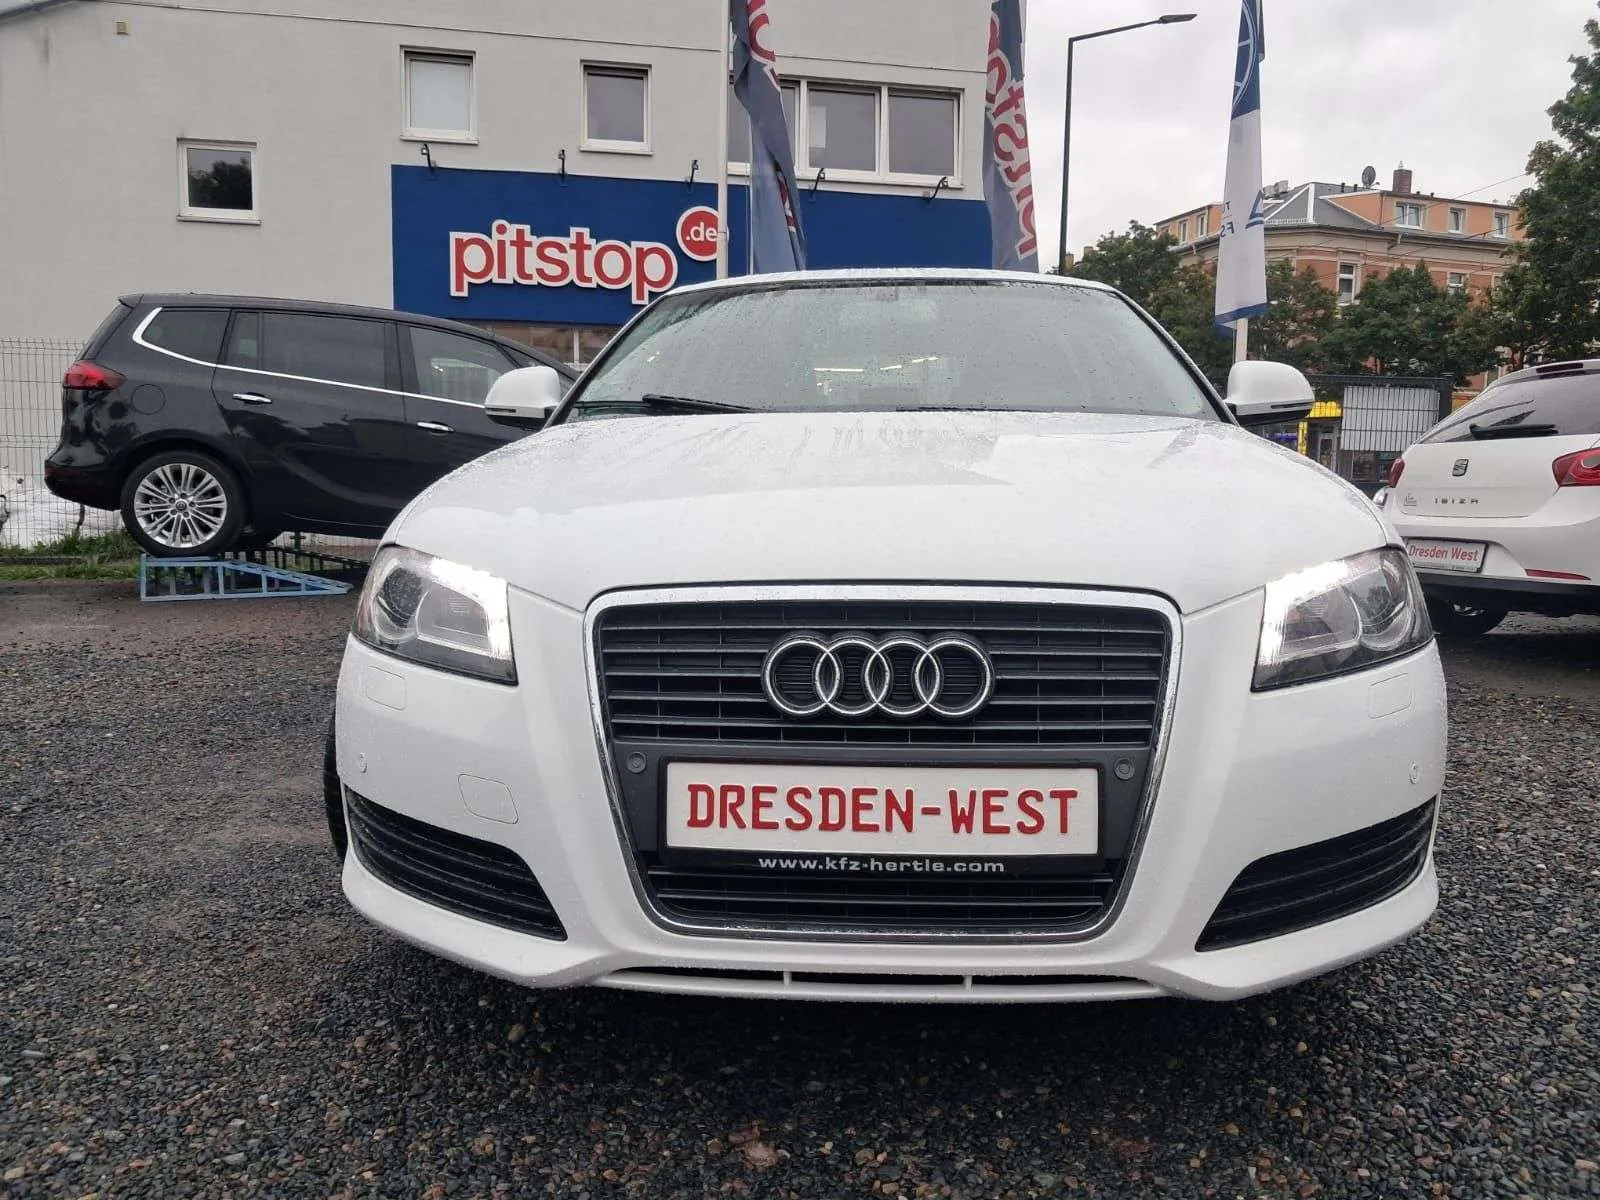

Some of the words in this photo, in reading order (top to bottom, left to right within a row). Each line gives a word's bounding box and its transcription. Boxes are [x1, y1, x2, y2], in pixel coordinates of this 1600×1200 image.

[452, 221, 676, 303] pitstop
[1408, 545, 1448, 559] Dresden
[1451, 547, 1480, 562] West
[687, 784, 1079, 834] DRESDEN-WEST
[758, 856, 1005, 873] www.kfz-hertle.com
